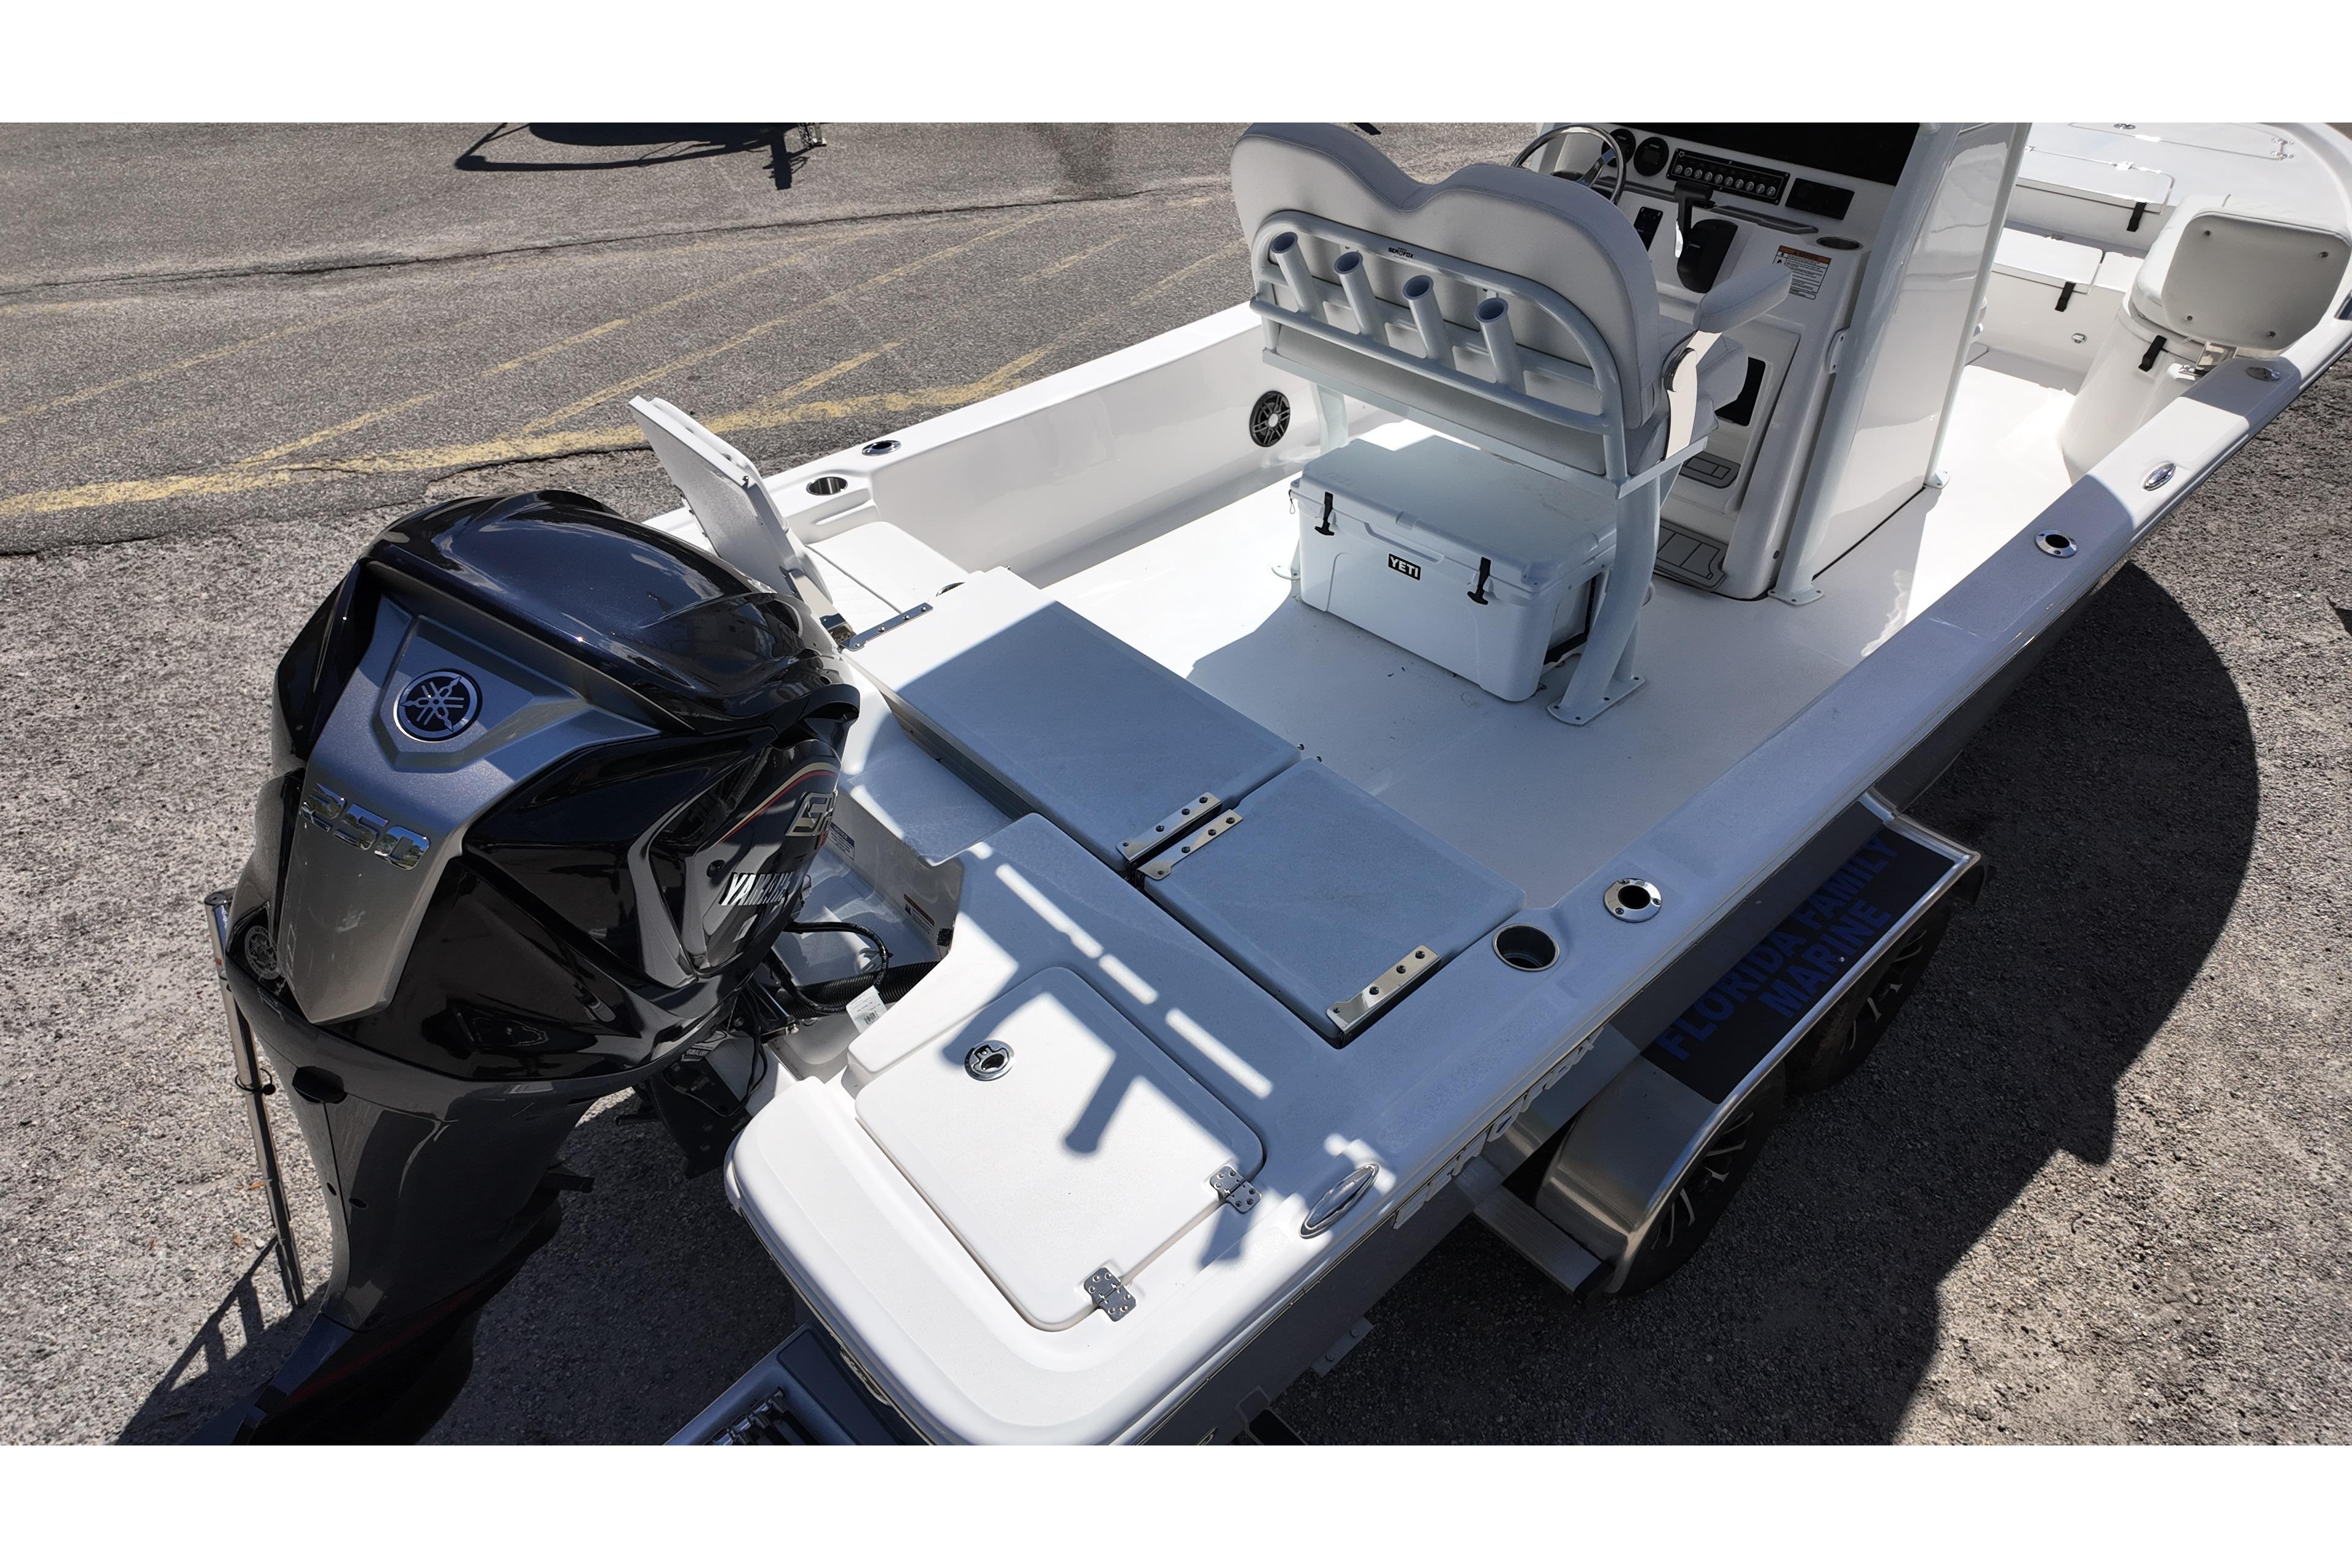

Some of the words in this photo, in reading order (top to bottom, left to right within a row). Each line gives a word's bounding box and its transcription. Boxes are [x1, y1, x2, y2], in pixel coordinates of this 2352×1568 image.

[1390, 556, 1419, 578] YETI
[300, 783, 431, 870] 250
[1657, 929, 1807, 1061] FLORIDA
[1793, 836, 1898, 930] FAMILY
[1757, 899, 1891, 1019] MARINE
